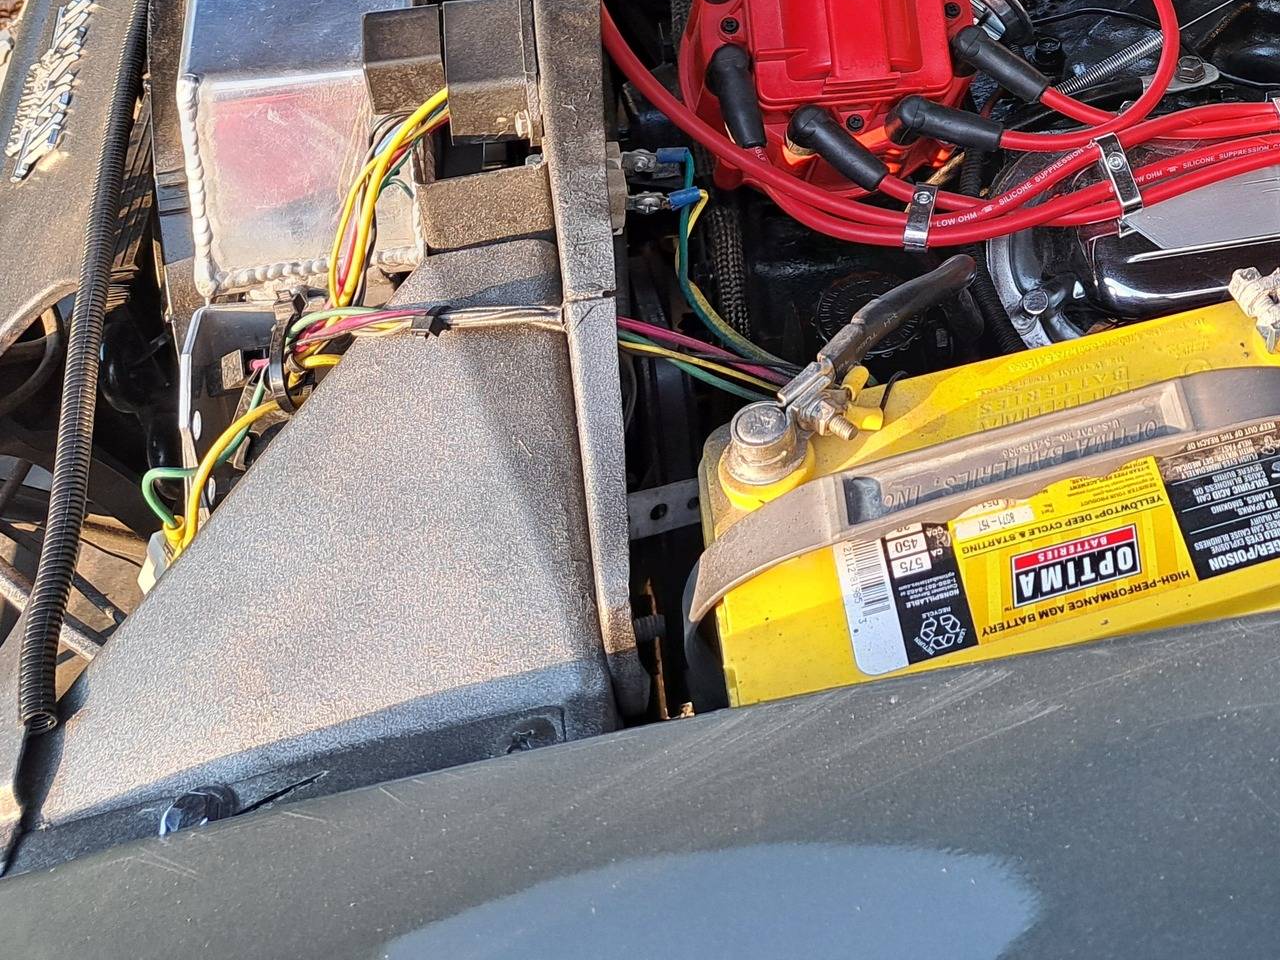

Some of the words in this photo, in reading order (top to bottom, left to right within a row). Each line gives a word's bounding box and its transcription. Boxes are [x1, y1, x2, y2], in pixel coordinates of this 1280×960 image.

[1146, 170, 1163, 180] OHM
[1183, 155, 1215, 169] SILICONE
[1219, 145, 1270, 160] SUPPRESSION
[936, 218, 955, 227] LOW
[958, 212, 977, 223] OHM
[998, 181, 1033, 205] SILICONE
[1035, 148, 1084, 183] SUPPRESSION
[1243, 425, 1257, 434] OUT
[1258, 421, 1275, 431] KEEP
[1195, 435, 1218, 447] REACH
[1219, 431, 1232, 440] THE
[1185, 441, 1195, 450] OF
[1221, 457, 1237, 467] EYES
[1211, 469, 1236, 482] BURNS
[1242, 469, 1266, 482] CAUSE
[1192, 486, 1203, 495] OR
[1204, 475, 1242, 492] BLINDNESS
[1230, 476, 1269, 493] SULFURIC
[1195, 492, 1211, 503] CAN
[1211, 487, 1230, 499] ACID
[1079, 494, 1108, 507] PRODUCT
[1210, 498, 1243, 514] SMOKING
[1264, 497, 1277, 508] NO
[1063, 512, 1092, 527] DEEP
[1249, 512, 1272, 526] INJURY
[925, 525, 944, 537] CCA
[1018, 530, 1026, 539] &
[1027, 520, 1062, 537] CYCLE
[1229, 527, 1250, 540] CAUSE
[1250, 523, 1264, 534] CAN
[893, 536, 919, 554] 450
[960, 532, 1015, 554] STARTING
[1193, 533, 1229, 550] BLINDNESS
[1244, 532, 1263, 544] EYES
[929, 547, 943, 557] CA
[1036, 534, 1108, 562] BATTERIES
[1210, 537, 1244, 554] EXPLOSIVE
[898, 556, 924, 574] 575
[1017, 544, 1136, 598] OPTIMA
[1067, 568, 1190, 611] HIGH-PERFORMANCE
[905, 588, 959, 608] NONSPILLABLE
[921, 605, 951, 618] RECYCLE
[1037, 603, 1065, 619] AGM
[979, 612, 1036, 636] BATTERY
[957, 627, 967, 643] LEAD
[913, 636, 935, 654] RETURN
